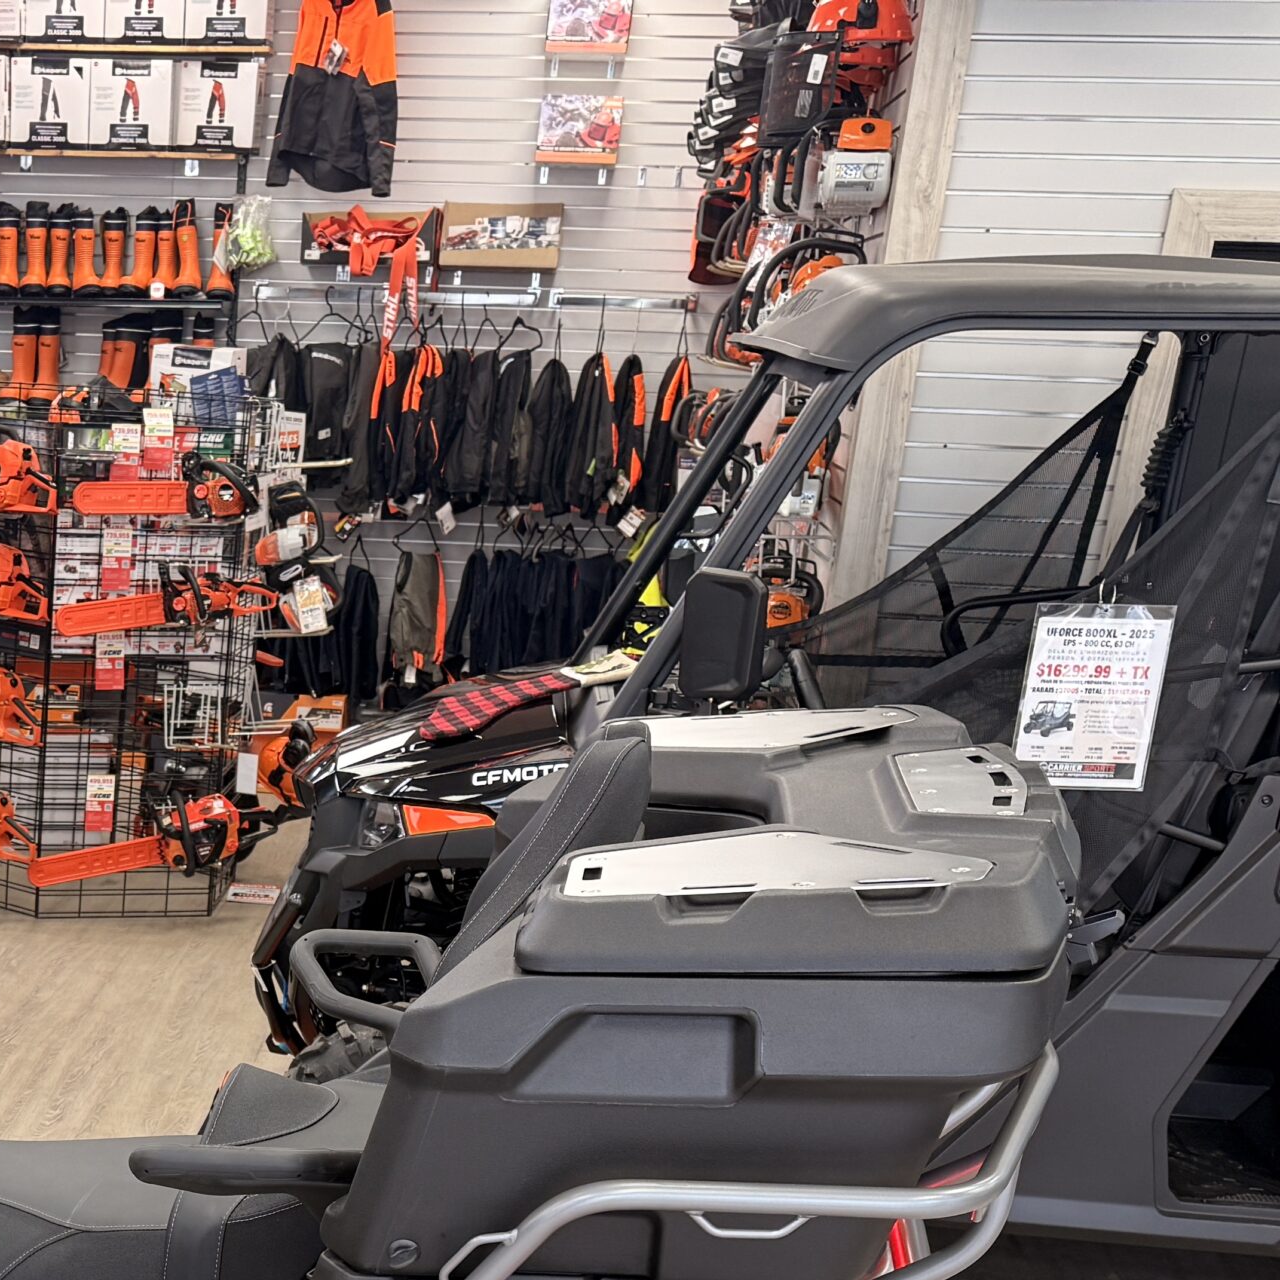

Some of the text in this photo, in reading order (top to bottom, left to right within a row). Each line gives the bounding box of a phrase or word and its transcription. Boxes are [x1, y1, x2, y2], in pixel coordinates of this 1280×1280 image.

[383, 292, 400, 340] STIHL
[1047, 627, 1084, 637] UFORCE
[1085, 628, 1118, 639] 800XL
[1129, 629, 1156, 639] 2025
